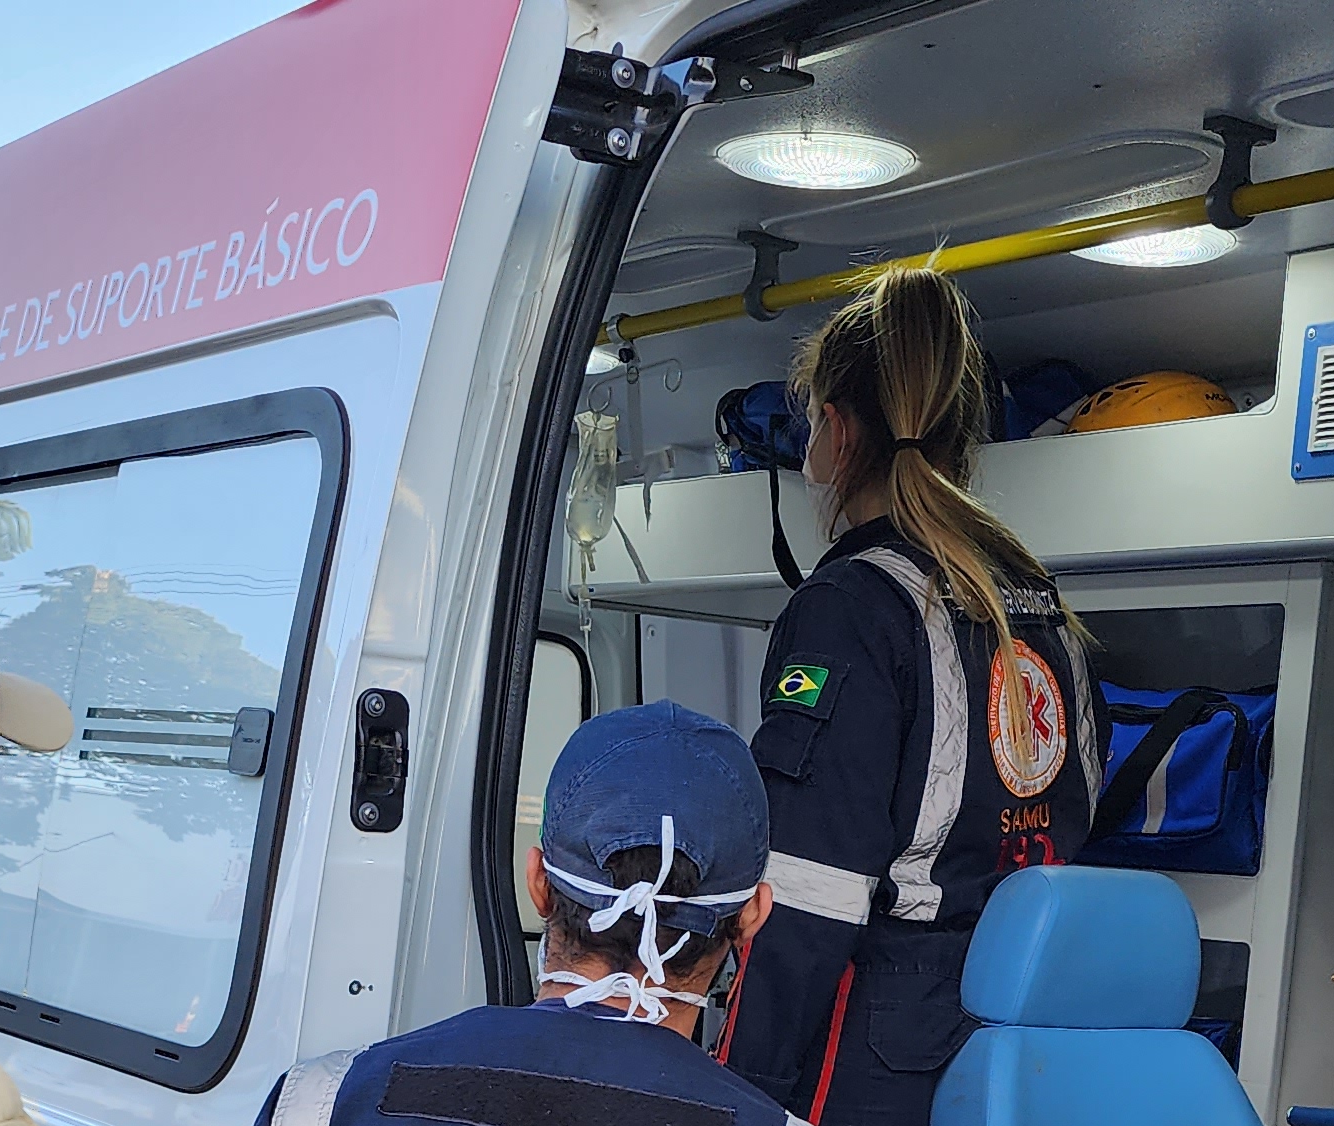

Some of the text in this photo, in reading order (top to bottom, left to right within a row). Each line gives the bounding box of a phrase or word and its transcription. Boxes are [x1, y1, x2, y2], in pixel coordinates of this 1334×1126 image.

[14, 289, 62, 358] DE
[57, 240, 217, 346] SUPORTE
[215, 188, 379, 302] BÁSICO
[1000, 802, 1051, 834] SAMU
